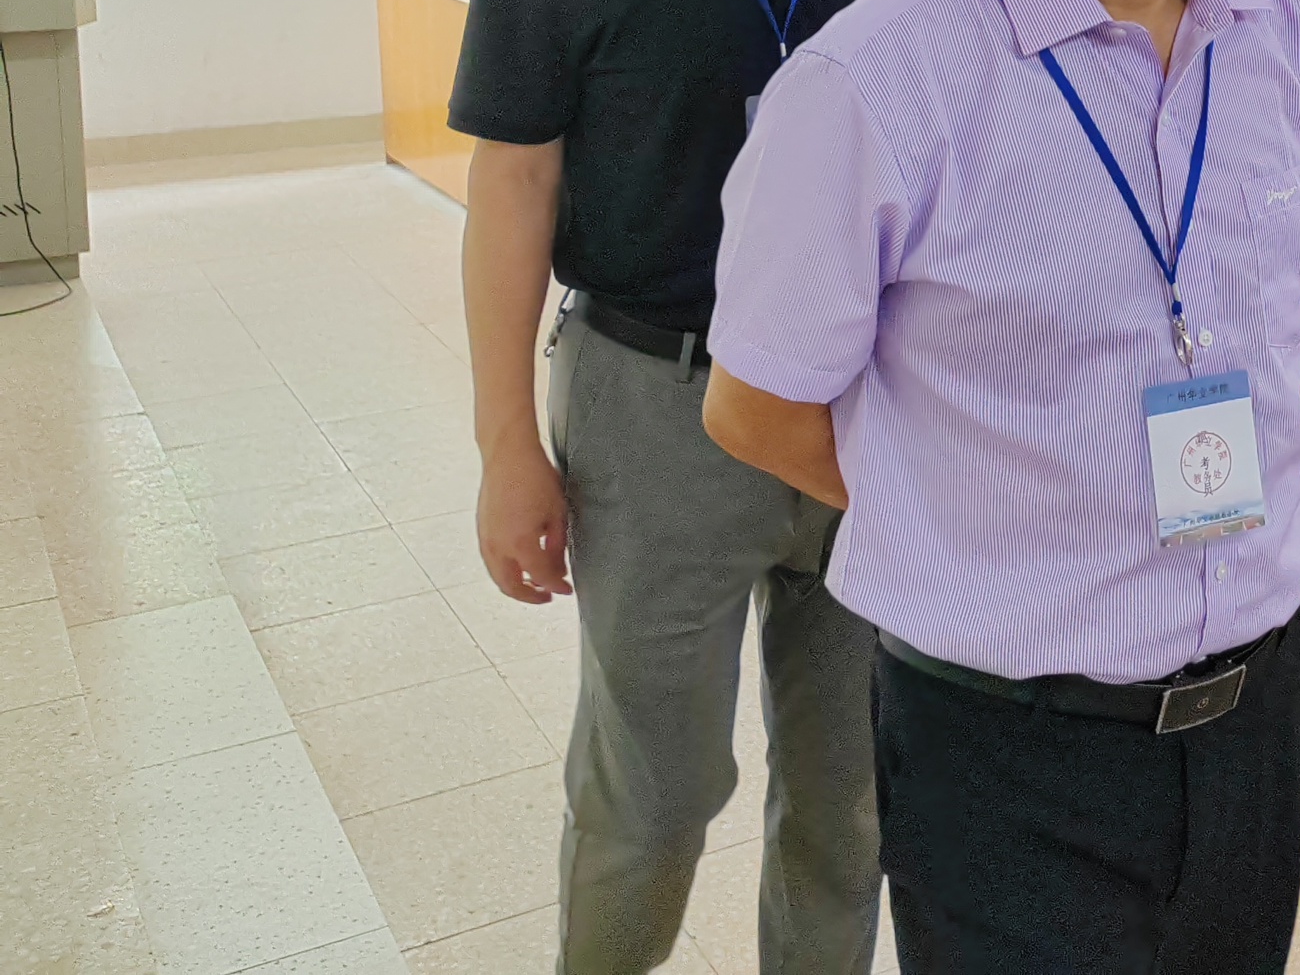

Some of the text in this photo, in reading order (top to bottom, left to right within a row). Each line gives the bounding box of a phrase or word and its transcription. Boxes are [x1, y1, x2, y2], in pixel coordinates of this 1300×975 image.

[1167, 383, 1229, 403] 广州华立学院
